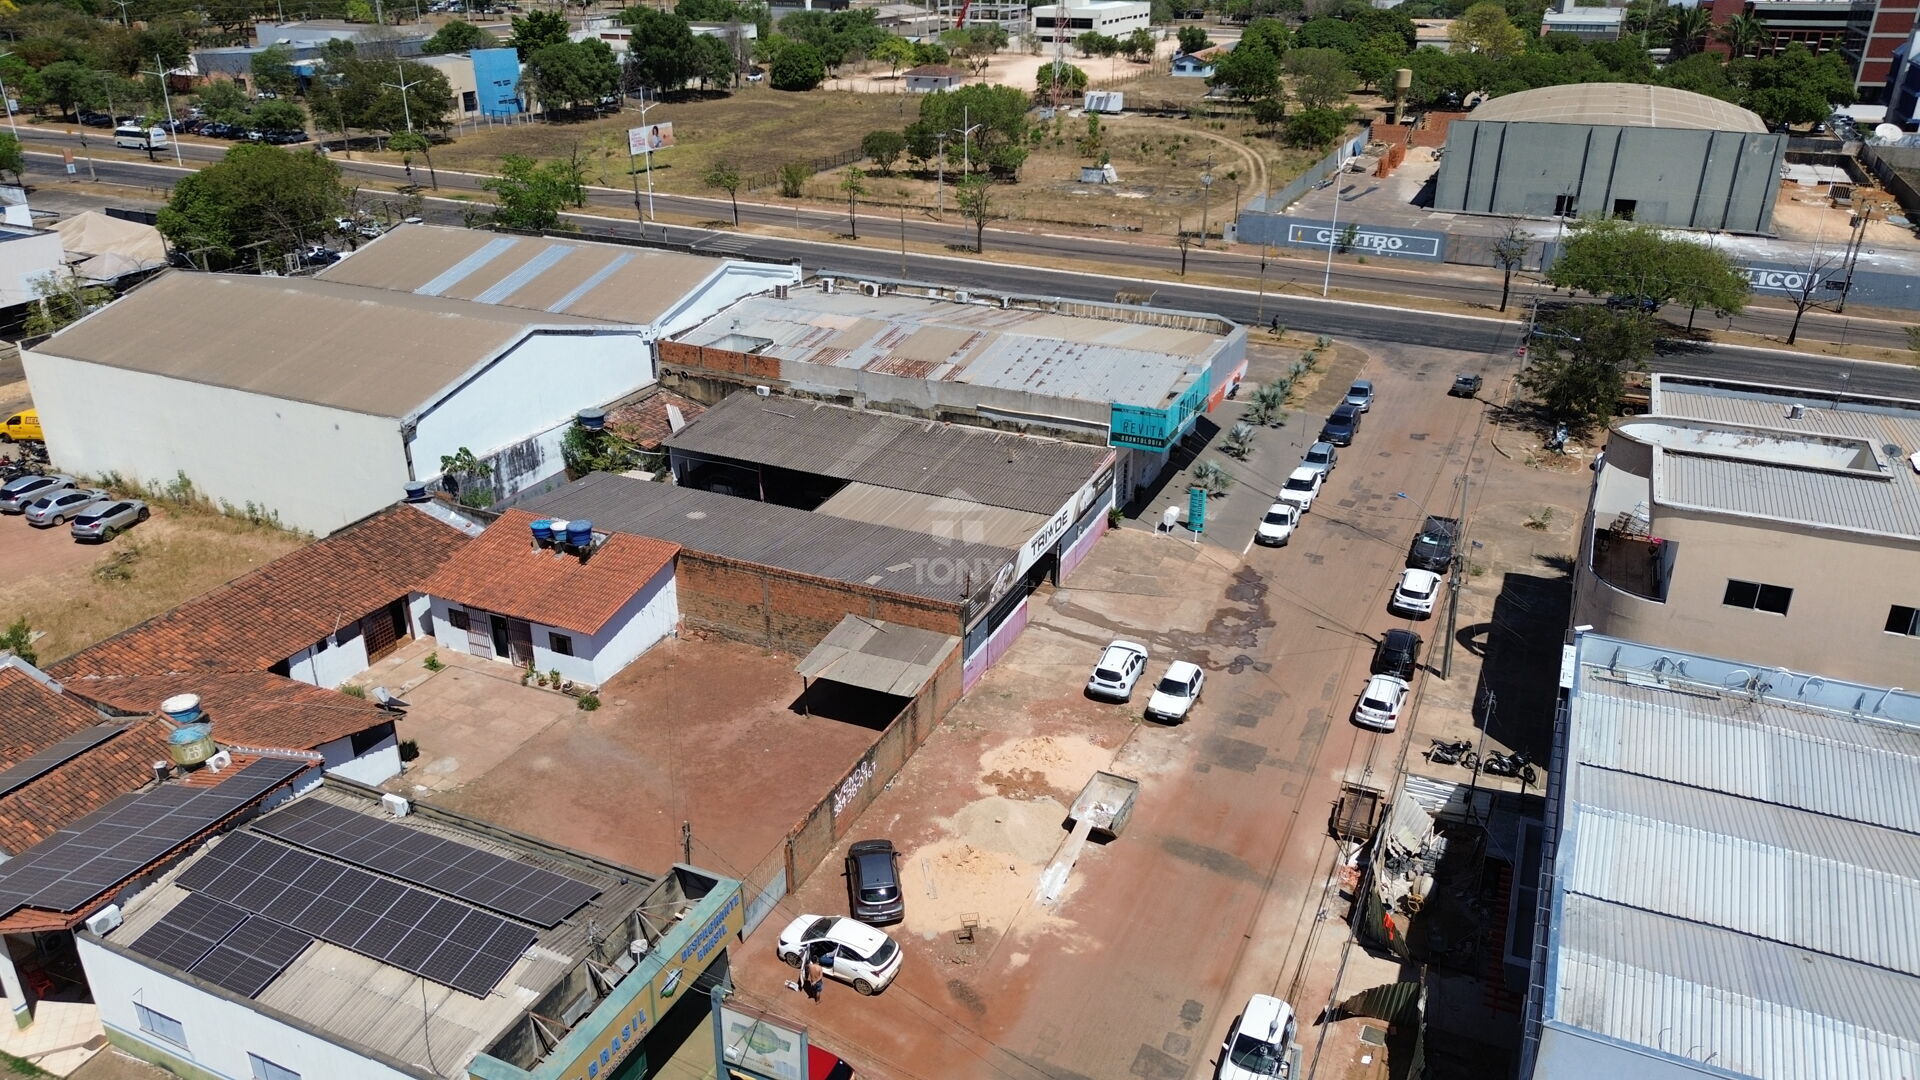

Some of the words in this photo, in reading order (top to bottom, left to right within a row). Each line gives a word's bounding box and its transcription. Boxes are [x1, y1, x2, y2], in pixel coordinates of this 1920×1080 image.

[1123, 422, 1164, 437] REVITA
[834, 761, 867, 800] VENDO
[697, 924, 728, 962] BRASIL
[588, 1007, 647, 1080] BRASIL
